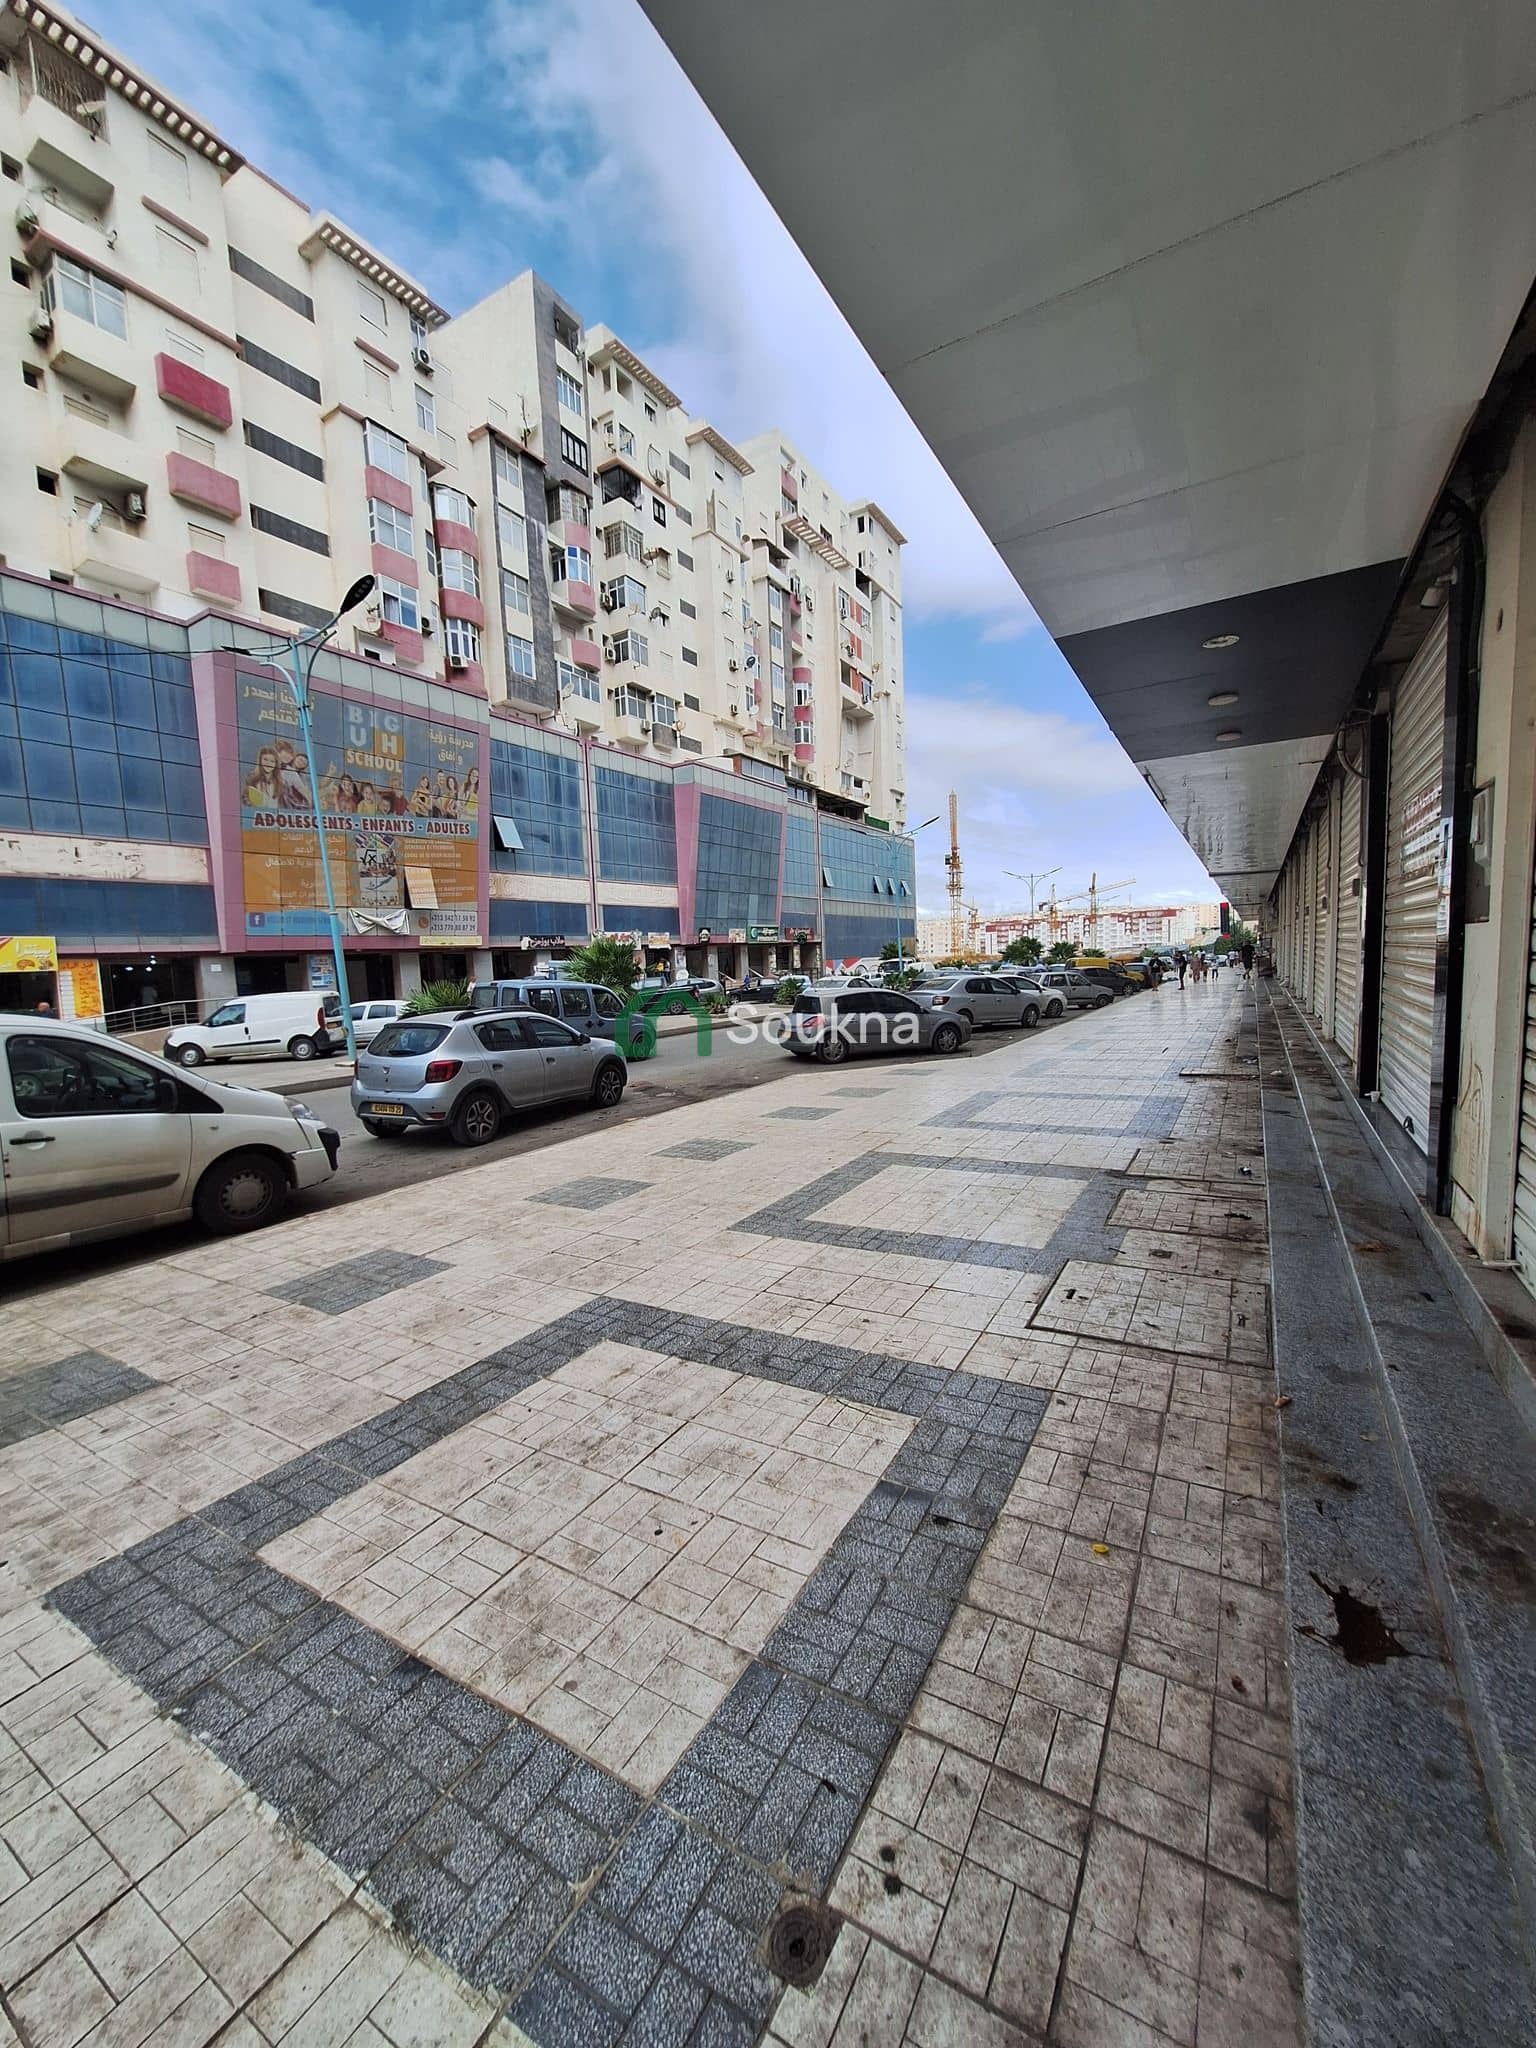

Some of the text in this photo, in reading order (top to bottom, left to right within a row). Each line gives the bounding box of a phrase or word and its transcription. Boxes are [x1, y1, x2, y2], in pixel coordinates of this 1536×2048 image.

[347, 749, 403, 773] SCHOOL
[254, 812, 353, 831] ADOLESCENTS
[362, 818, 415, 834] ENFANTS
[426, 821, 471, 836] ADULTES
